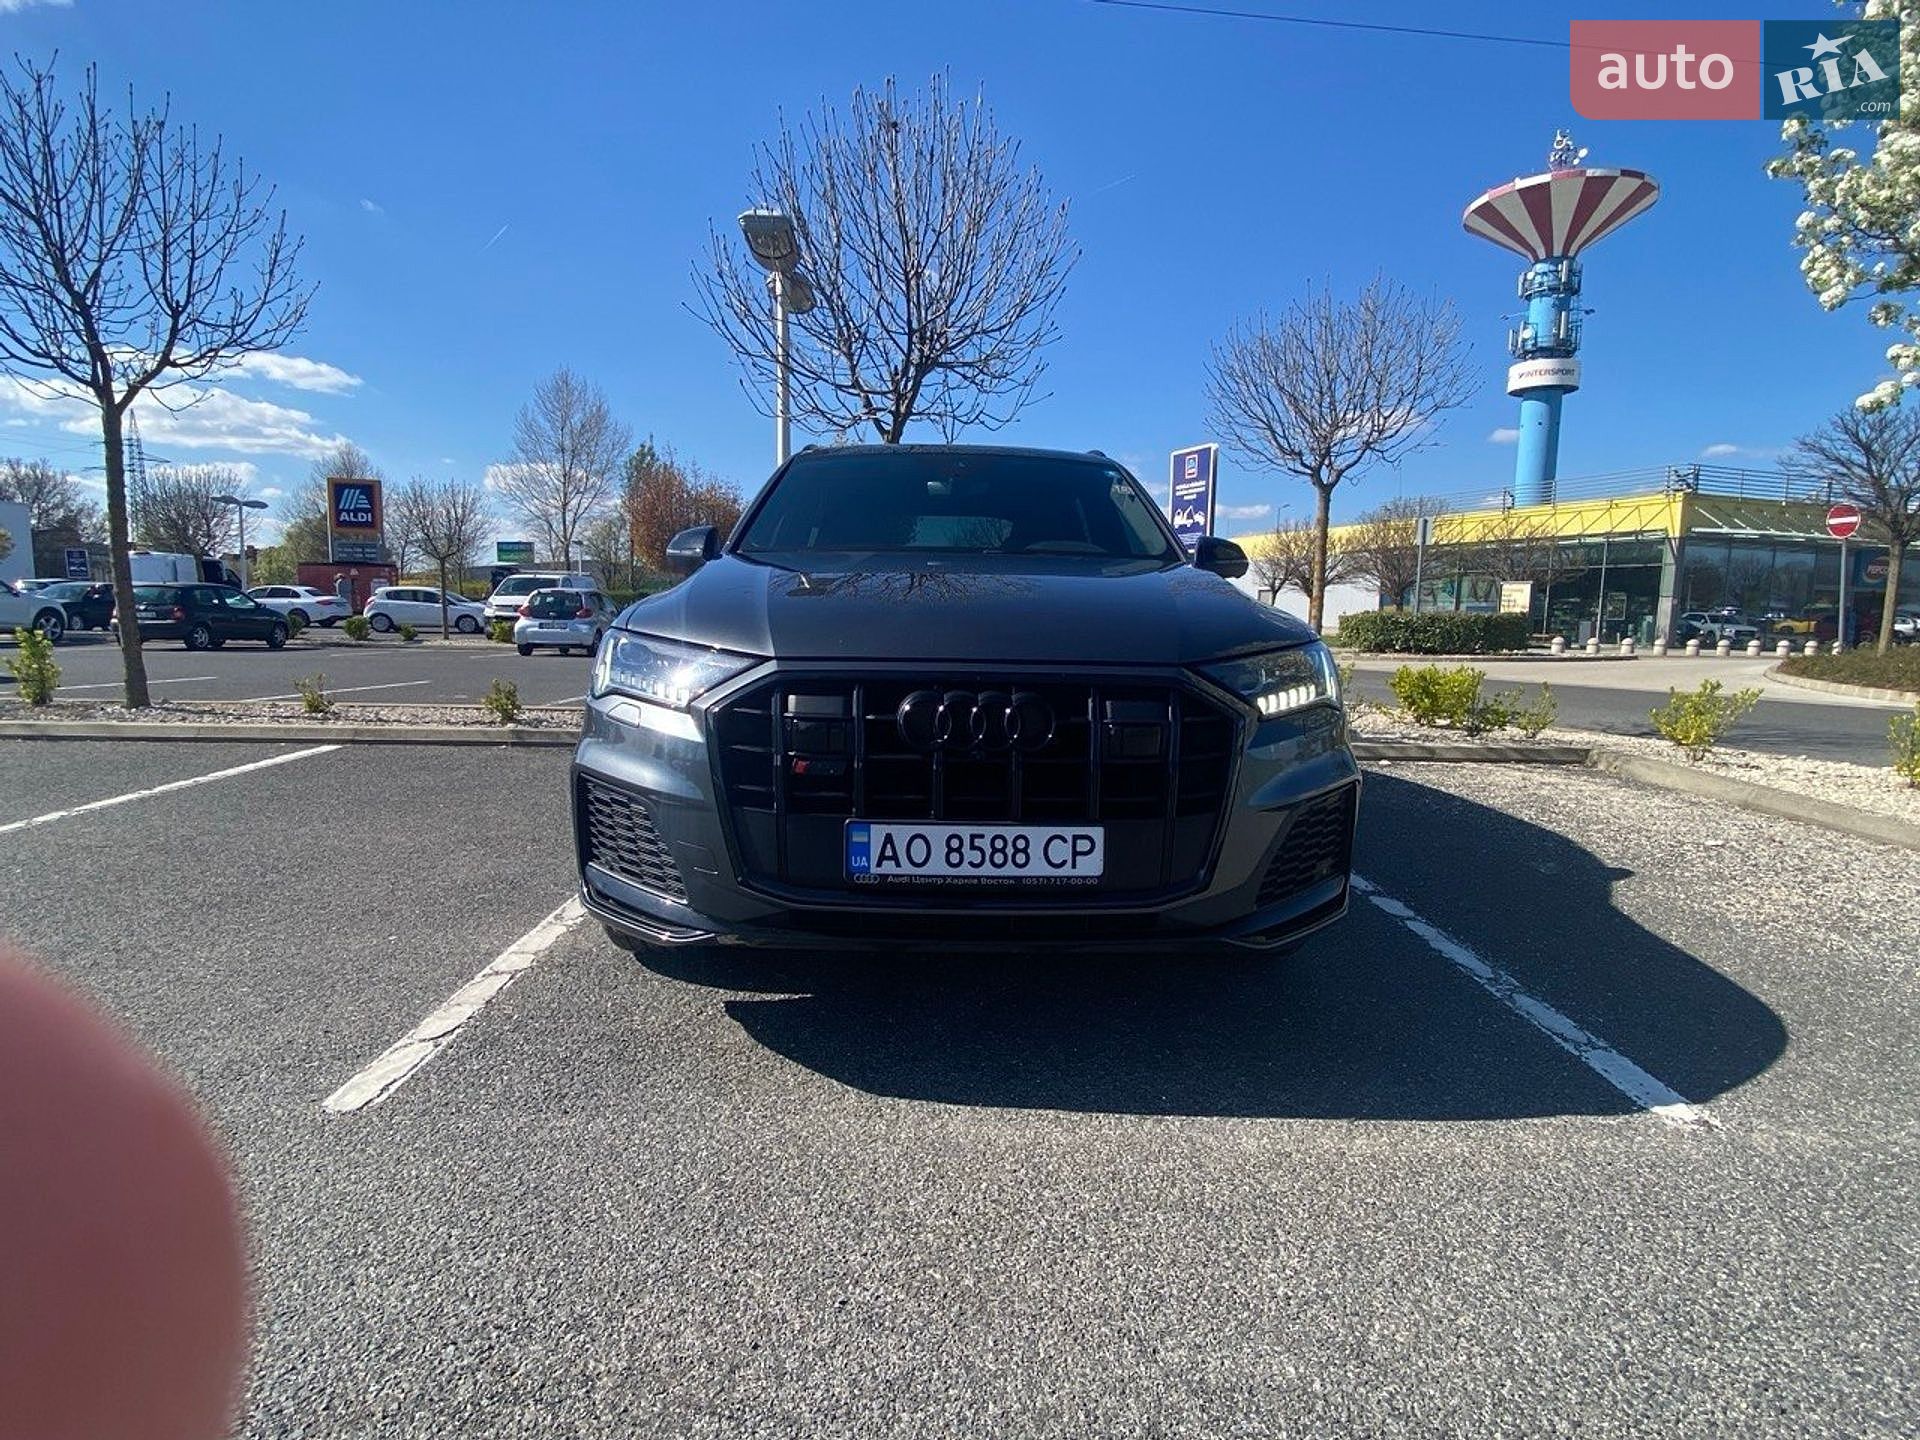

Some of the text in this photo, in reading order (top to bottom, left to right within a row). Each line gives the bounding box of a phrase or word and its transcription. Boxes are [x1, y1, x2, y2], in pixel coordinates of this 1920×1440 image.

[340, 512, 372, 522] ALDI
[875, 832, 1097, 870] AO 8588 CP
[851, 855, 869, 868] UA
[887, 875, 911, 883] Audi
